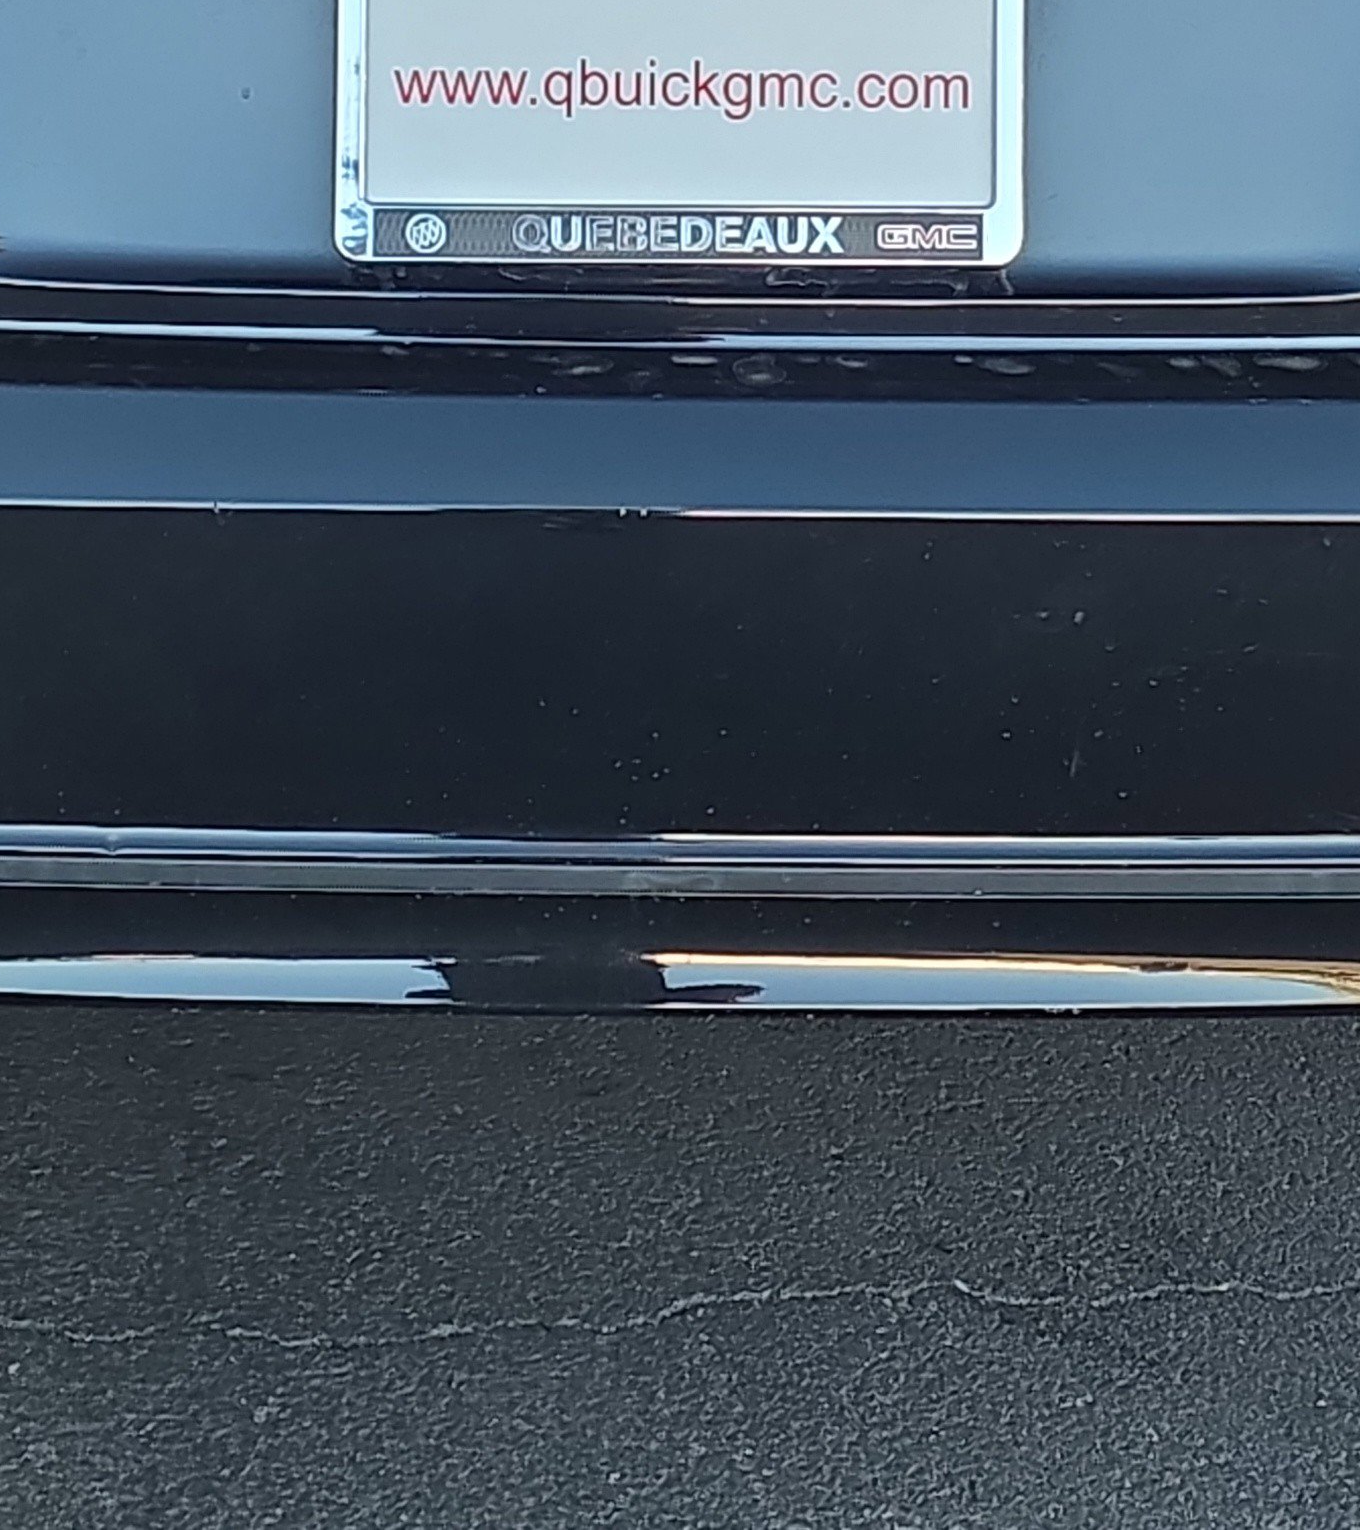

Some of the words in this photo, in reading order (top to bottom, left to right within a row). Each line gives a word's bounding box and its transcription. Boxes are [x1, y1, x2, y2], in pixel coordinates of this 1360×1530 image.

[393, 57, 972, 122] www.qbuickgmc.com
[511, 214, 846, 255] QUEBEDEAUX
[876, 222, 979, 252] GMC
